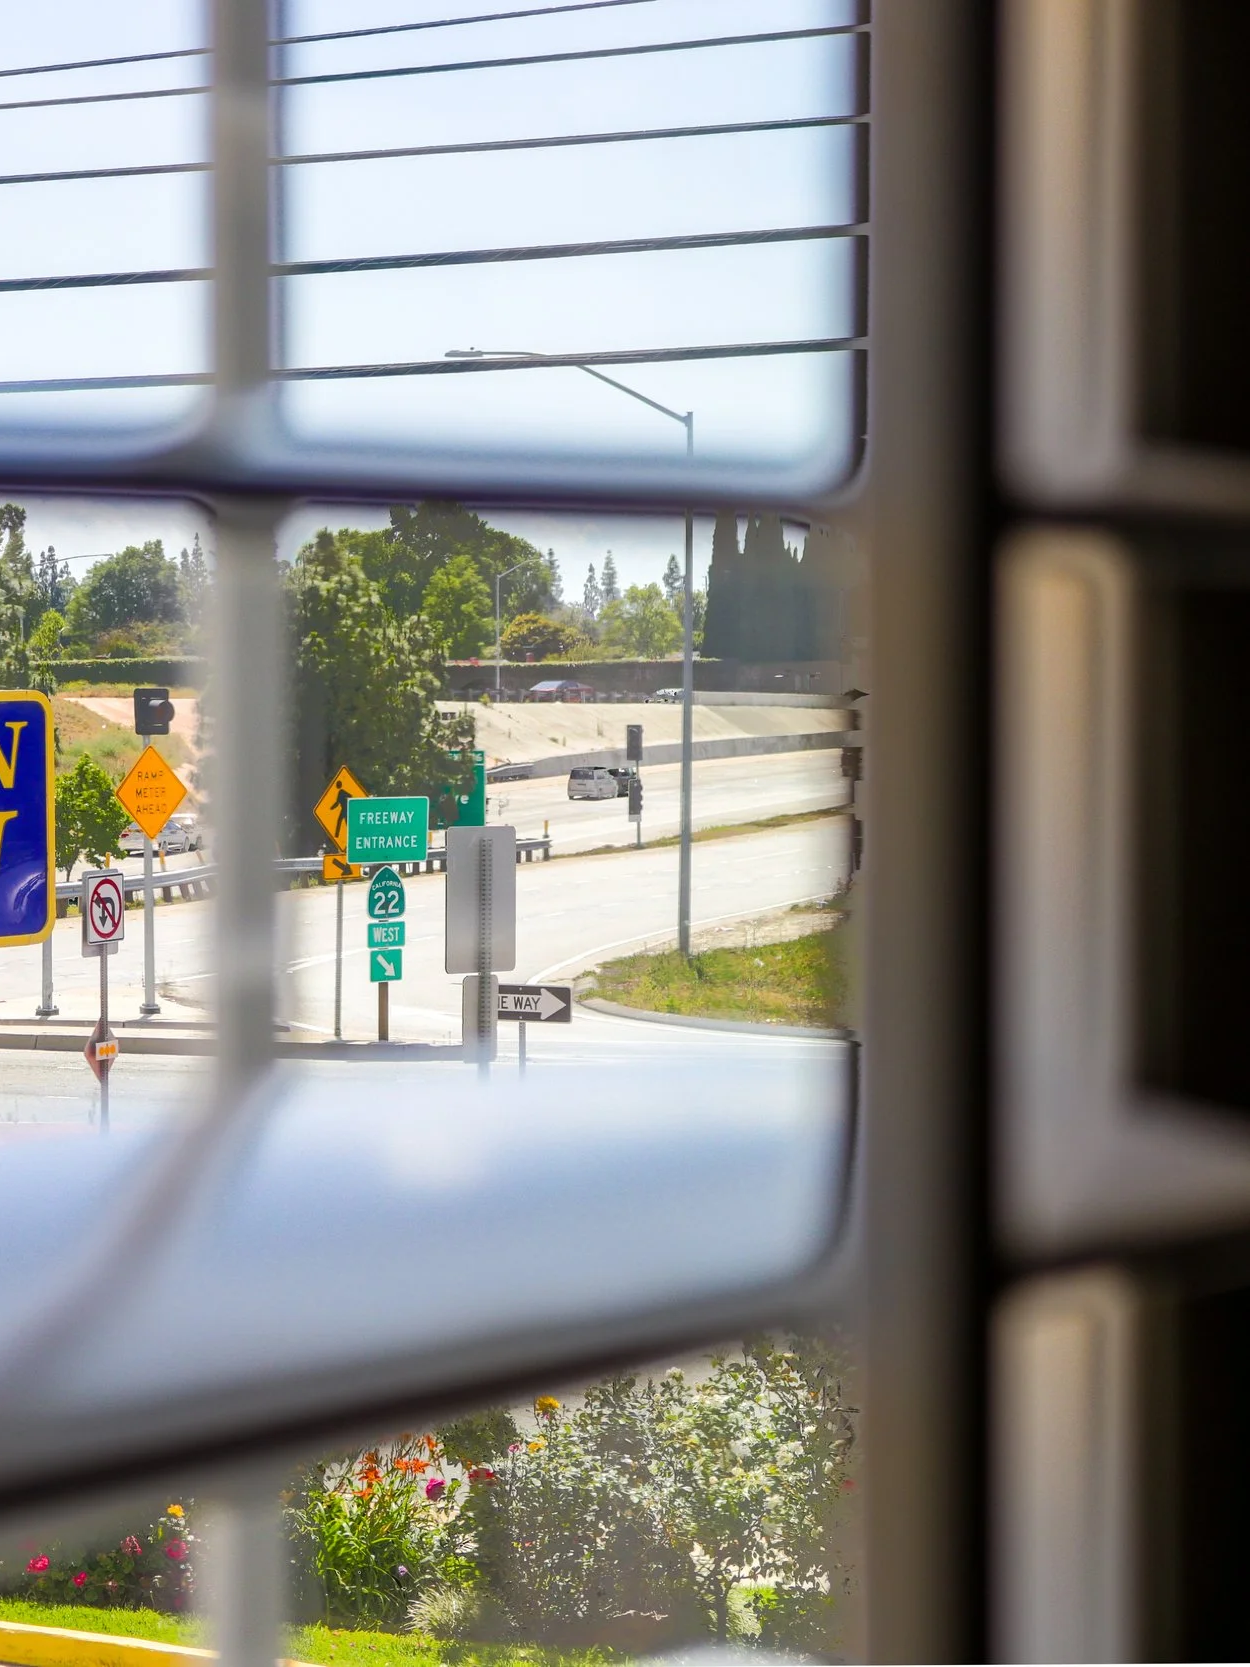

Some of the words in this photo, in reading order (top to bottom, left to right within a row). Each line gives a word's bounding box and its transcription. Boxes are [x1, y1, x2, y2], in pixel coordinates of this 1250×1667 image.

[137, 770, 164, 781] RAMP
[135, 787, 166, 799] METER
[136, 803, 167, 815] AHEAD
[359, 811, 415, 825] FREEWAY
[355, 835, 418, 850] ENTRANCE
[372, 880, 402, 891] CALIFORNIA
[373, 890, 400, 915] 22
[373, 926, 400, 943] WEST
[513, 996, 541, 1011] WAY
